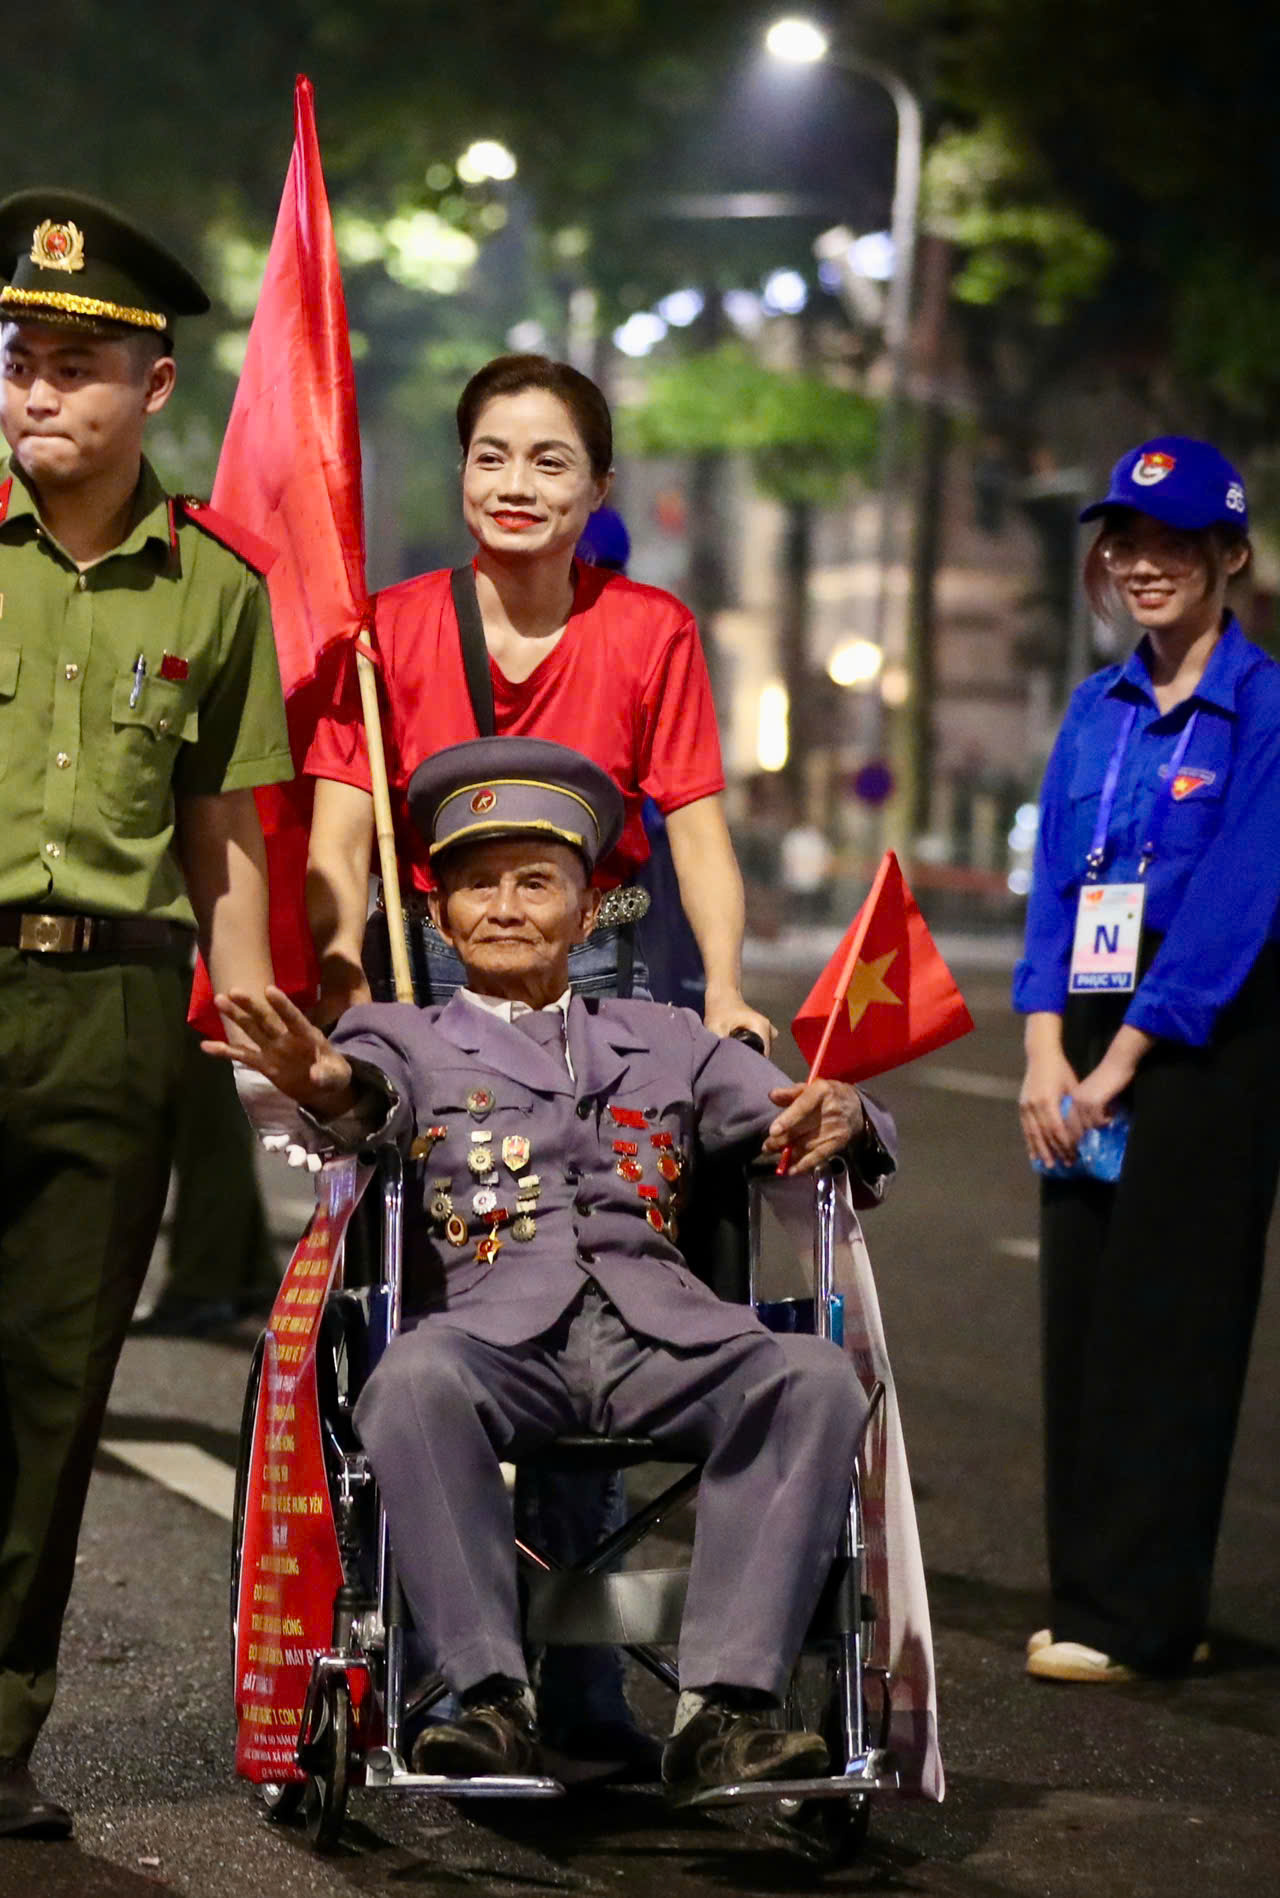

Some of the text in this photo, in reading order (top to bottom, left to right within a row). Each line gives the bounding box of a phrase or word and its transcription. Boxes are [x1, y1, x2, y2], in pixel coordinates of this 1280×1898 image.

[1094, 924, 1120, 954] N
[285, 1645, 305, 1667] MÁY
[279, 1708, 297, 1726] CON
